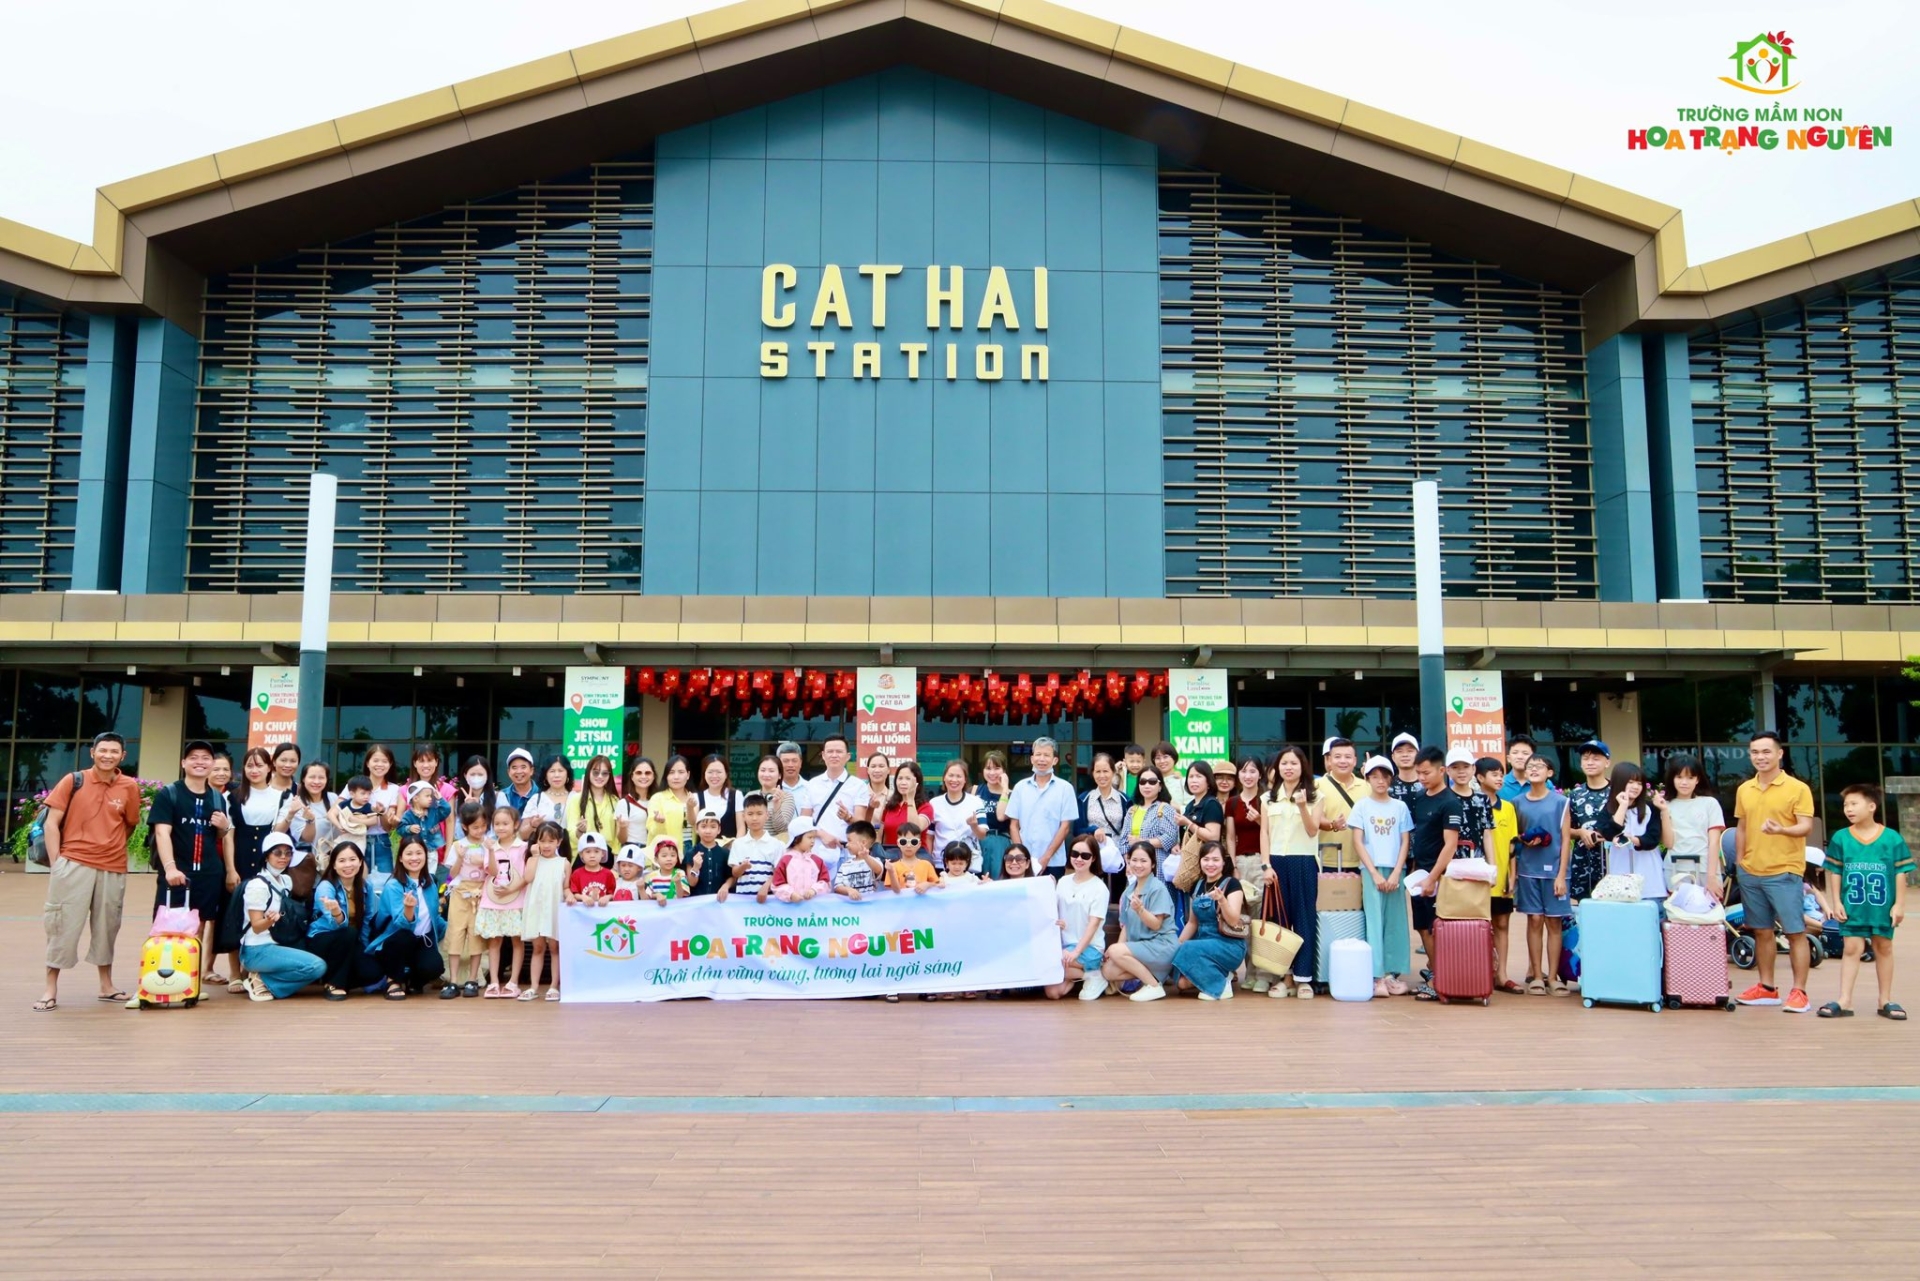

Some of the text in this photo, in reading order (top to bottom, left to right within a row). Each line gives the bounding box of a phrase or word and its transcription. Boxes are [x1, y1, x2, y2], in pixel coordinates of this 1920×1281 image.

[761, 263, 1048, 330] CAT HAI
[760, 341, 1049, 380] STATION
[252, 722, 263, 731] DI
[580, 718, 608, 728] SHOW
[860, 720, 911, 732] ĐẾN CÁT BÀ
[1187, 720, 1212, 734] CHỢ
[1450, 721, 1472, 734] TÂM
[264, 734, 292, 744] XANH
[574, 730, 612, 742] JETSKI
[861, 732, 911, 744] PHẢI UỐNG
[567, 745, 575, 757] 2
[877, 746, 896, 756] SUN
[1174, 736, 1225, 754] XANH
[1481, 737, 1502, 753] TRÍ
[1847, 872, 1887, 906] 33
[743, 913, 860, 927] TRƯỜNG MẦM NON
[670, 928, 934, 964] HOA TRẠNG NGUYÊN
[691, 965, 724, 983] đầu
[726, 966, 765, 983] vững
[814, 965, 857, 983] tương
[861, 963, 882, 978] lai
[886, 961, 920, 982] ngời
[923, 960, 963, 977] sáng
